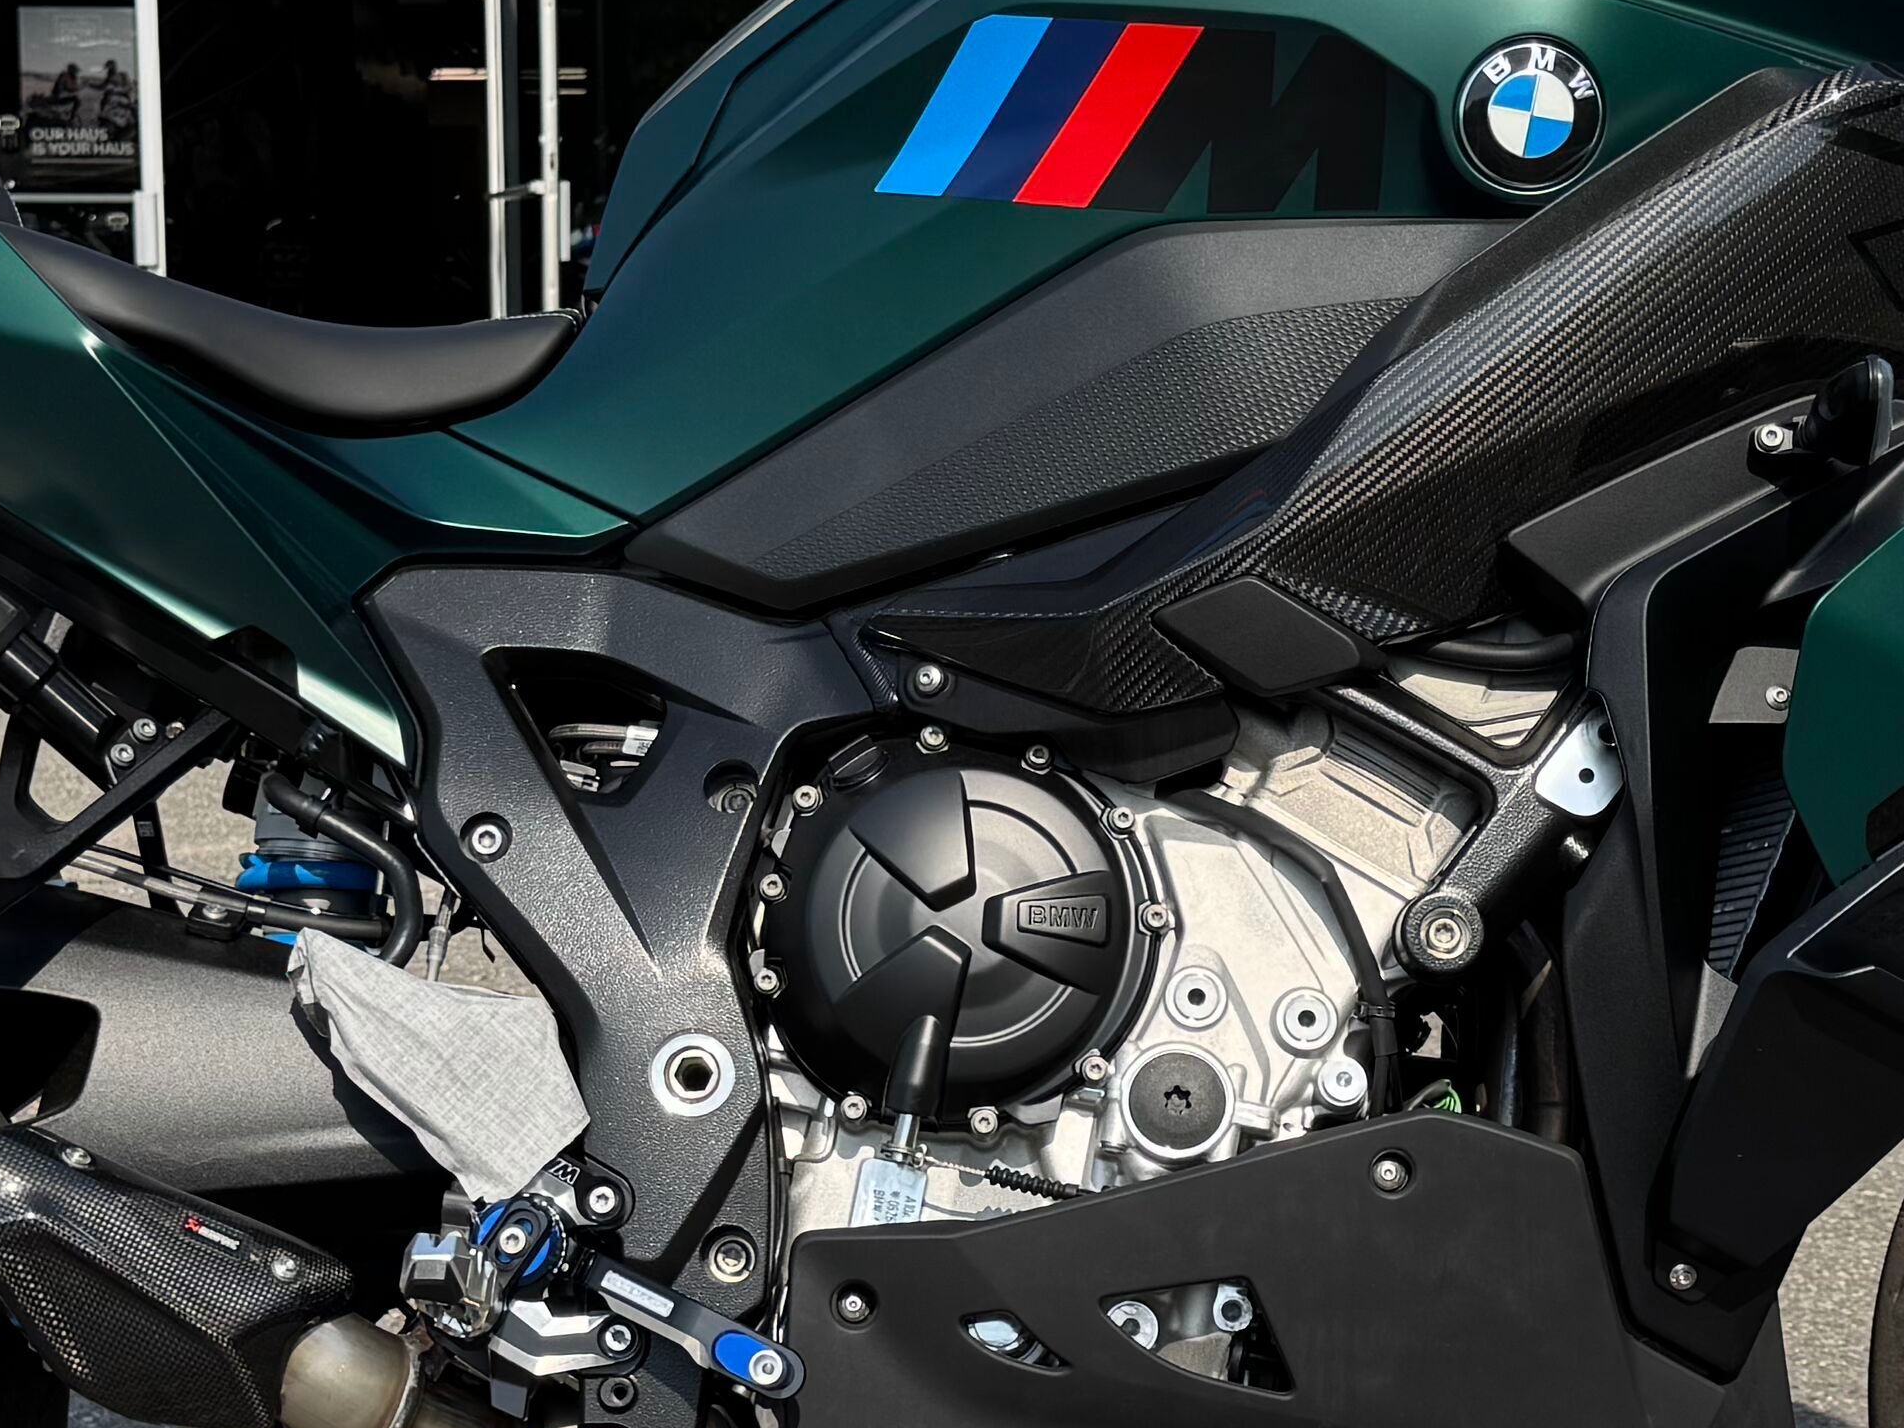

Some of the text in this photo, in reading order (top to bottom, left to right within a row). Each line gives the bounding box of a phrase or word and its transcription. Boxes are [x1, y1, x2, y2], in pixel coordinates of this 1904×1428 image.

[1483, 44, 1595, 101] BMW
[31, 127, 109, 141] OUR HAUS
[32, 142, 135, 156] IS YOUR HAUS
[1029, 904, 1098, 929] BMW
